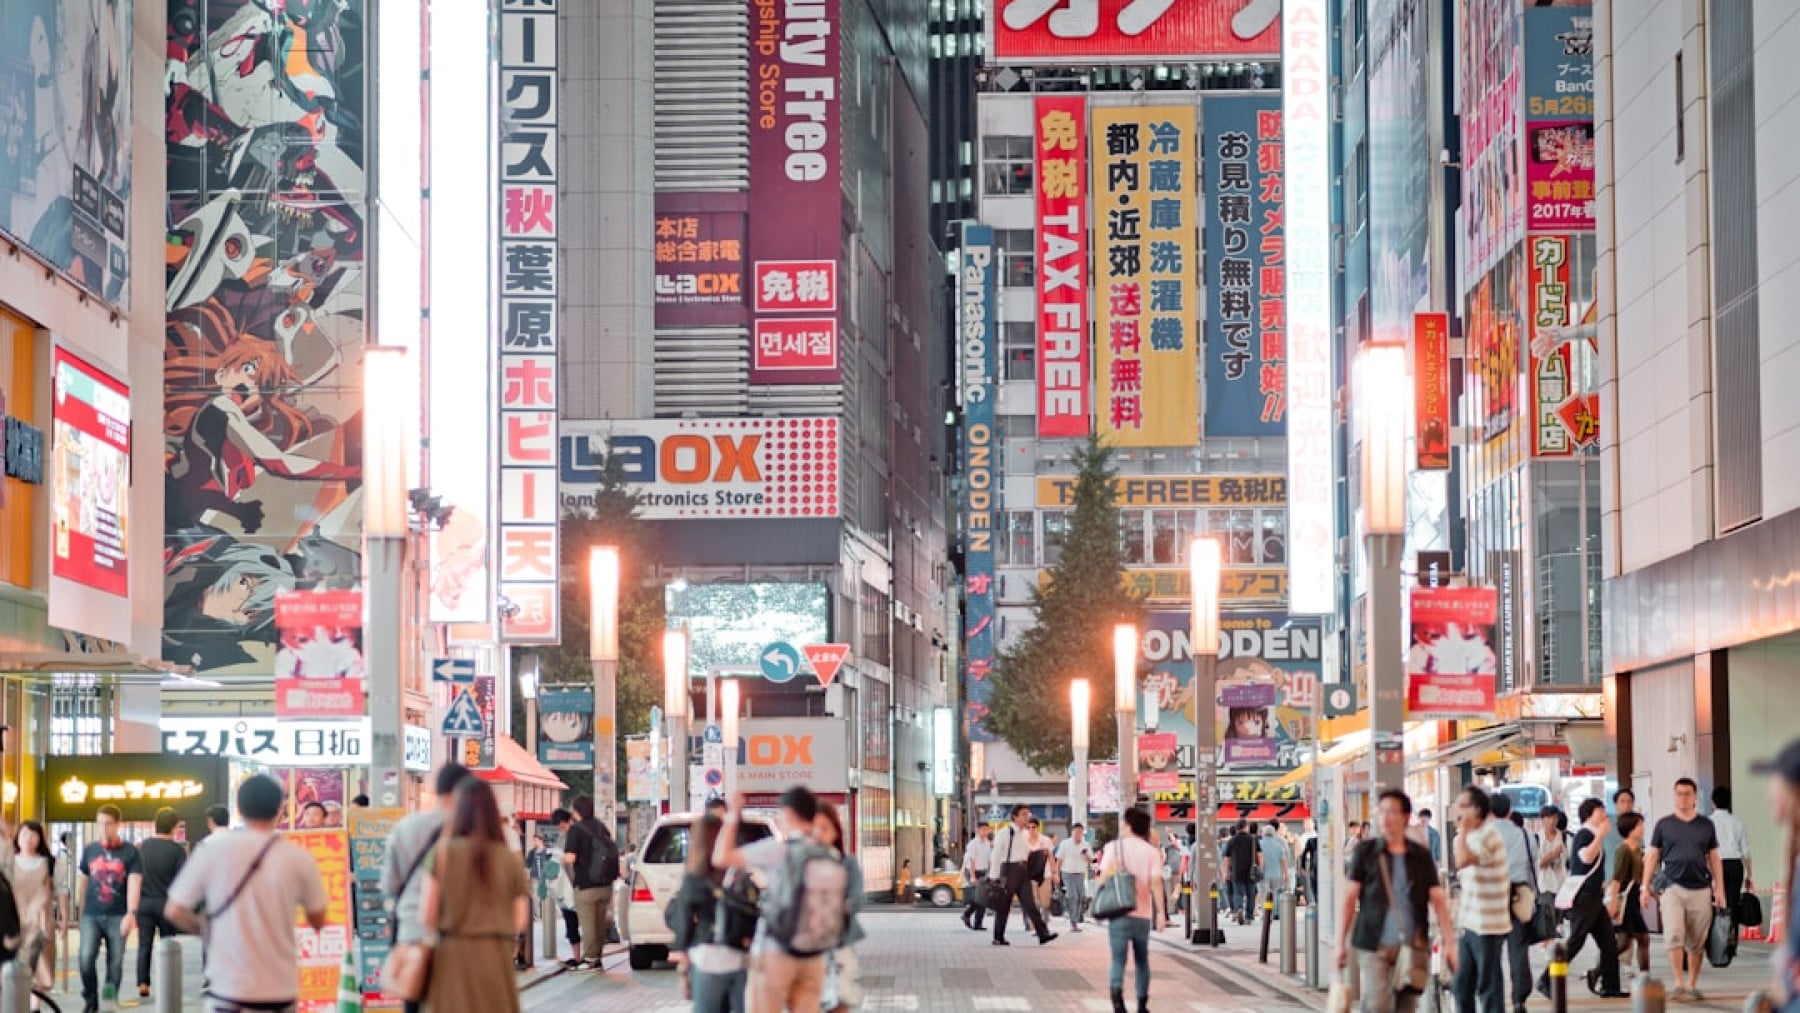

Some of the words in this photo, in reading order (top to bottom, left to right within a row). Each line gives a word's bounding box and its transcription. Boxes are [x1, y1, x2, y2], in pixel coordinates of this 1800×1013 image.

[759, 64, 781, 129] Store
[784, 77, 834, 182] Free
[1041, 109, 1079, 199] 免税
[656, 218, 698, 239] 本店
[1043, 206, 1081, 291] TAX
[1106, 122, 1143, 430] 都内・近郊送料無料
[1147, 121, 1184, 351] 冷蔵庫洗濯機
[1218, 132, 1252, 381] お見積り無料です
[505, 0, 553, 632] ークス秋葉原ホビー天国
[761, 270, 830, 302] 免税
[964, 245, 991, 403] Panasonic
[759, 331, 831, 357] 면세점
[1044, 303, 1081, 416] FREE
[638, 490, 709, 507] ctronics
[715, 490, 764, 506] Store
[968, 423, 991, 552] ONODEN
[1127, 480, 1211, 503] FREE
[1218, 478, 1288, 502] 免税店
